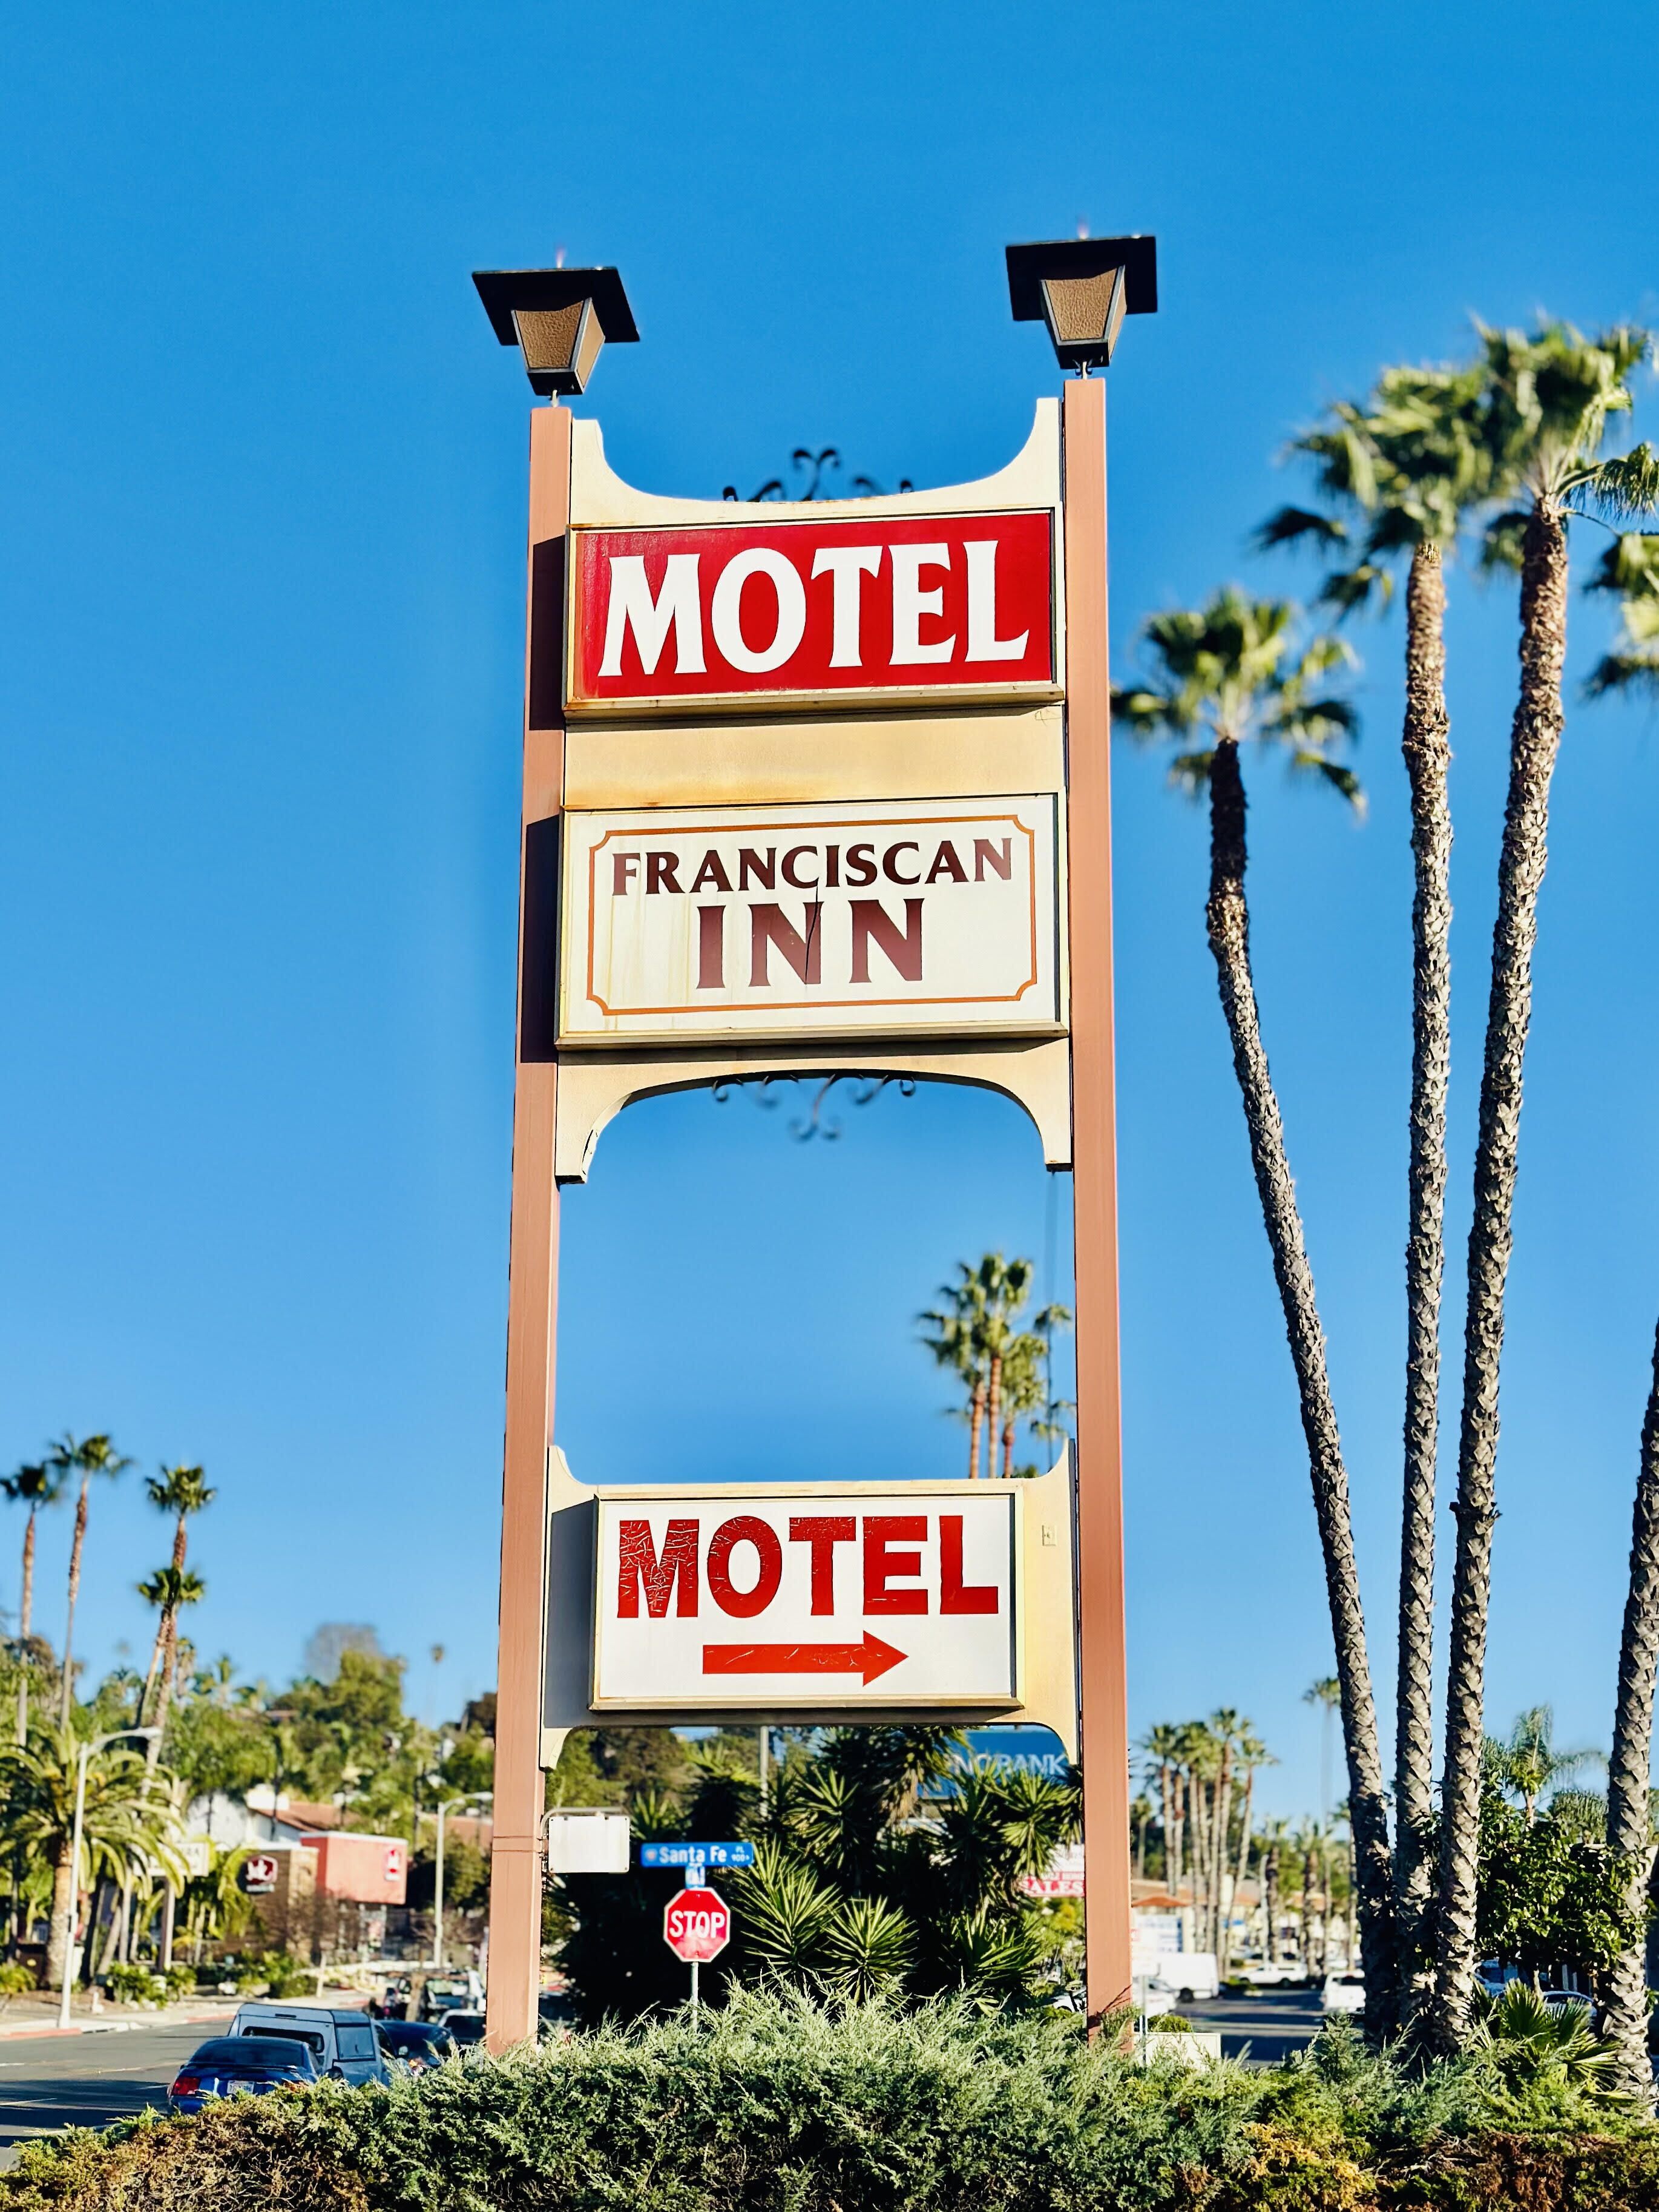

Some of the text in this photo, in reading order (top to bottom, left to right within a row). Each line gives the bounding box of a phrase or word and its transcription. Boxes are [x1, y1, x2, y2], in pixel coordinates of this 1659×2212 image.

[597, 540, 1030, 677] MOTEL
[612, 837, 1013, 897] FRANCISCAN
[695, 898, 925, 990] INN
[617, 1515, 999, 1619] MOTEL
[659, 1845, 728, 1864] Santa Fe
[669, 1910, 725, 1940] STOP
